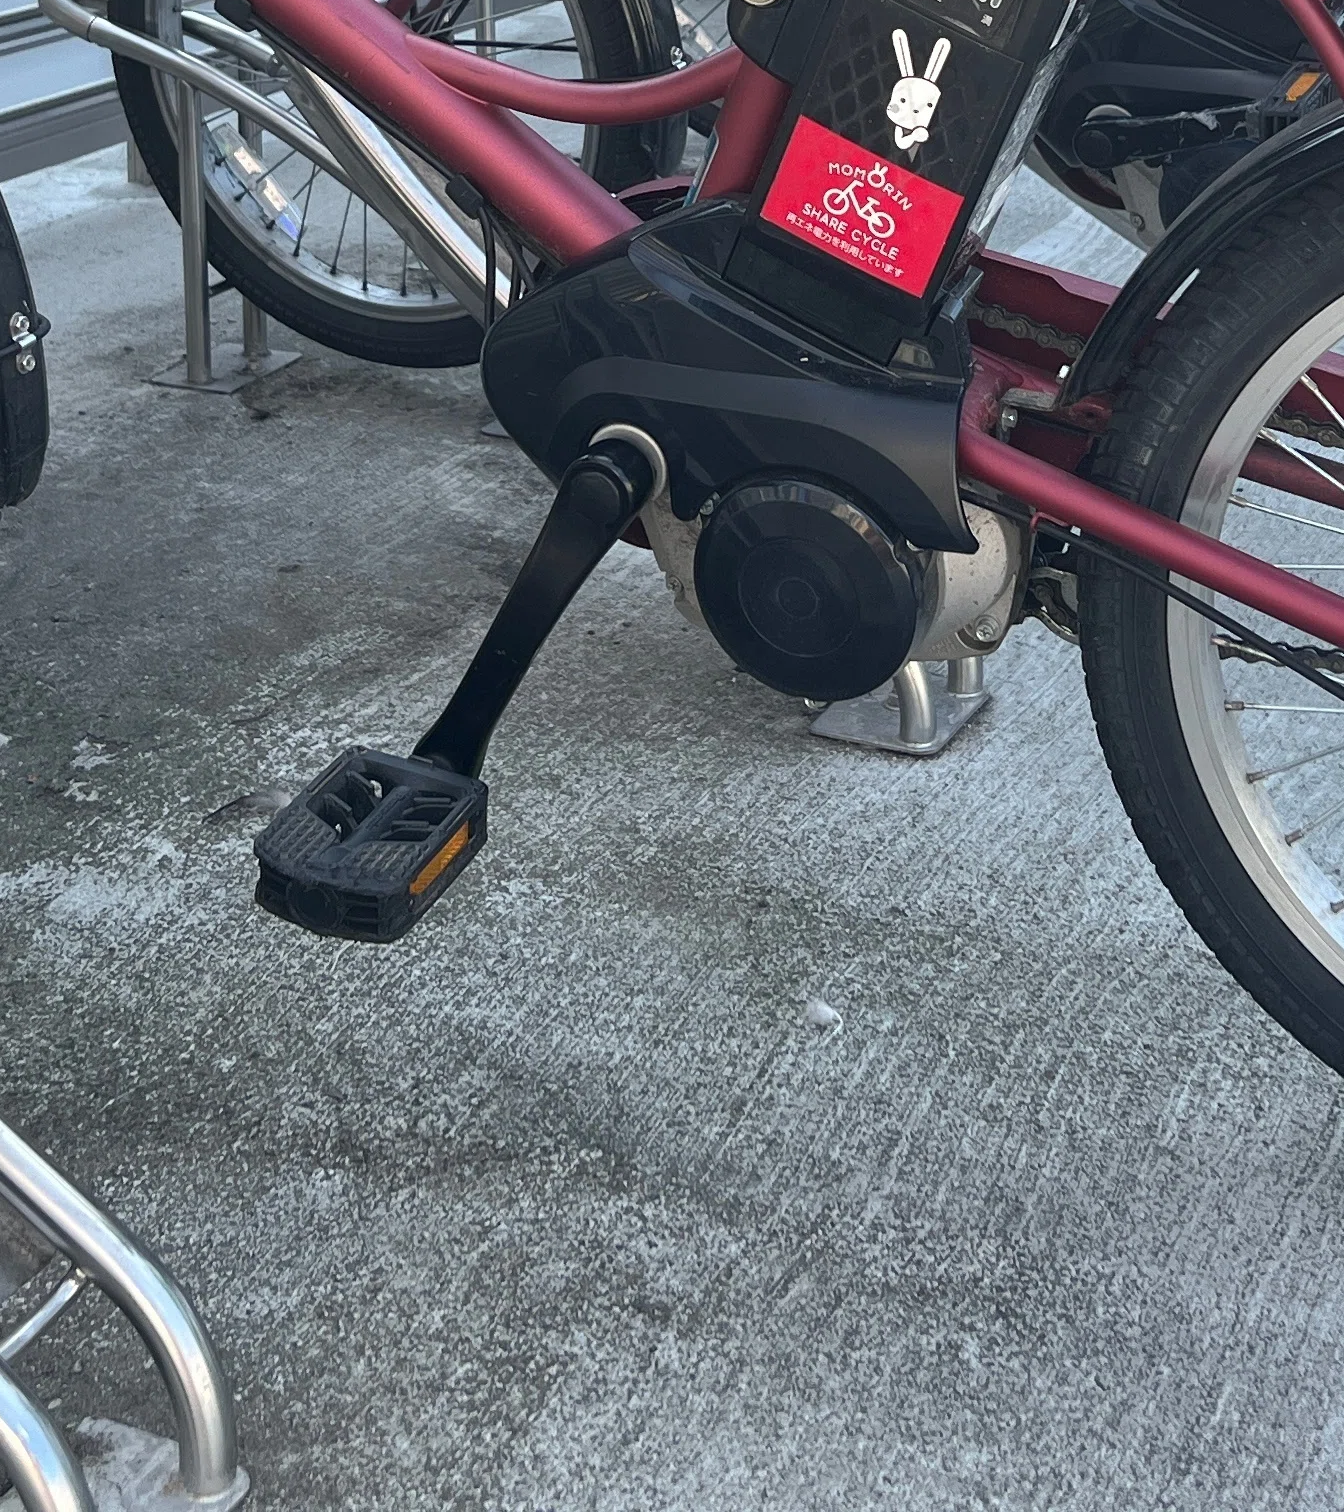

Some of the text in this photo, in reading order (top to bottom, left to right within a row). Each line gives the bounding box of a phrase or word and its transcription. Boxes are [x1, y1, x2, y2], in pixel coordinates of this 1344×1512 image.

[828, 161, 913, 211] MOMORIN
[801, 203, 899, 261] SHARE CYCLE
